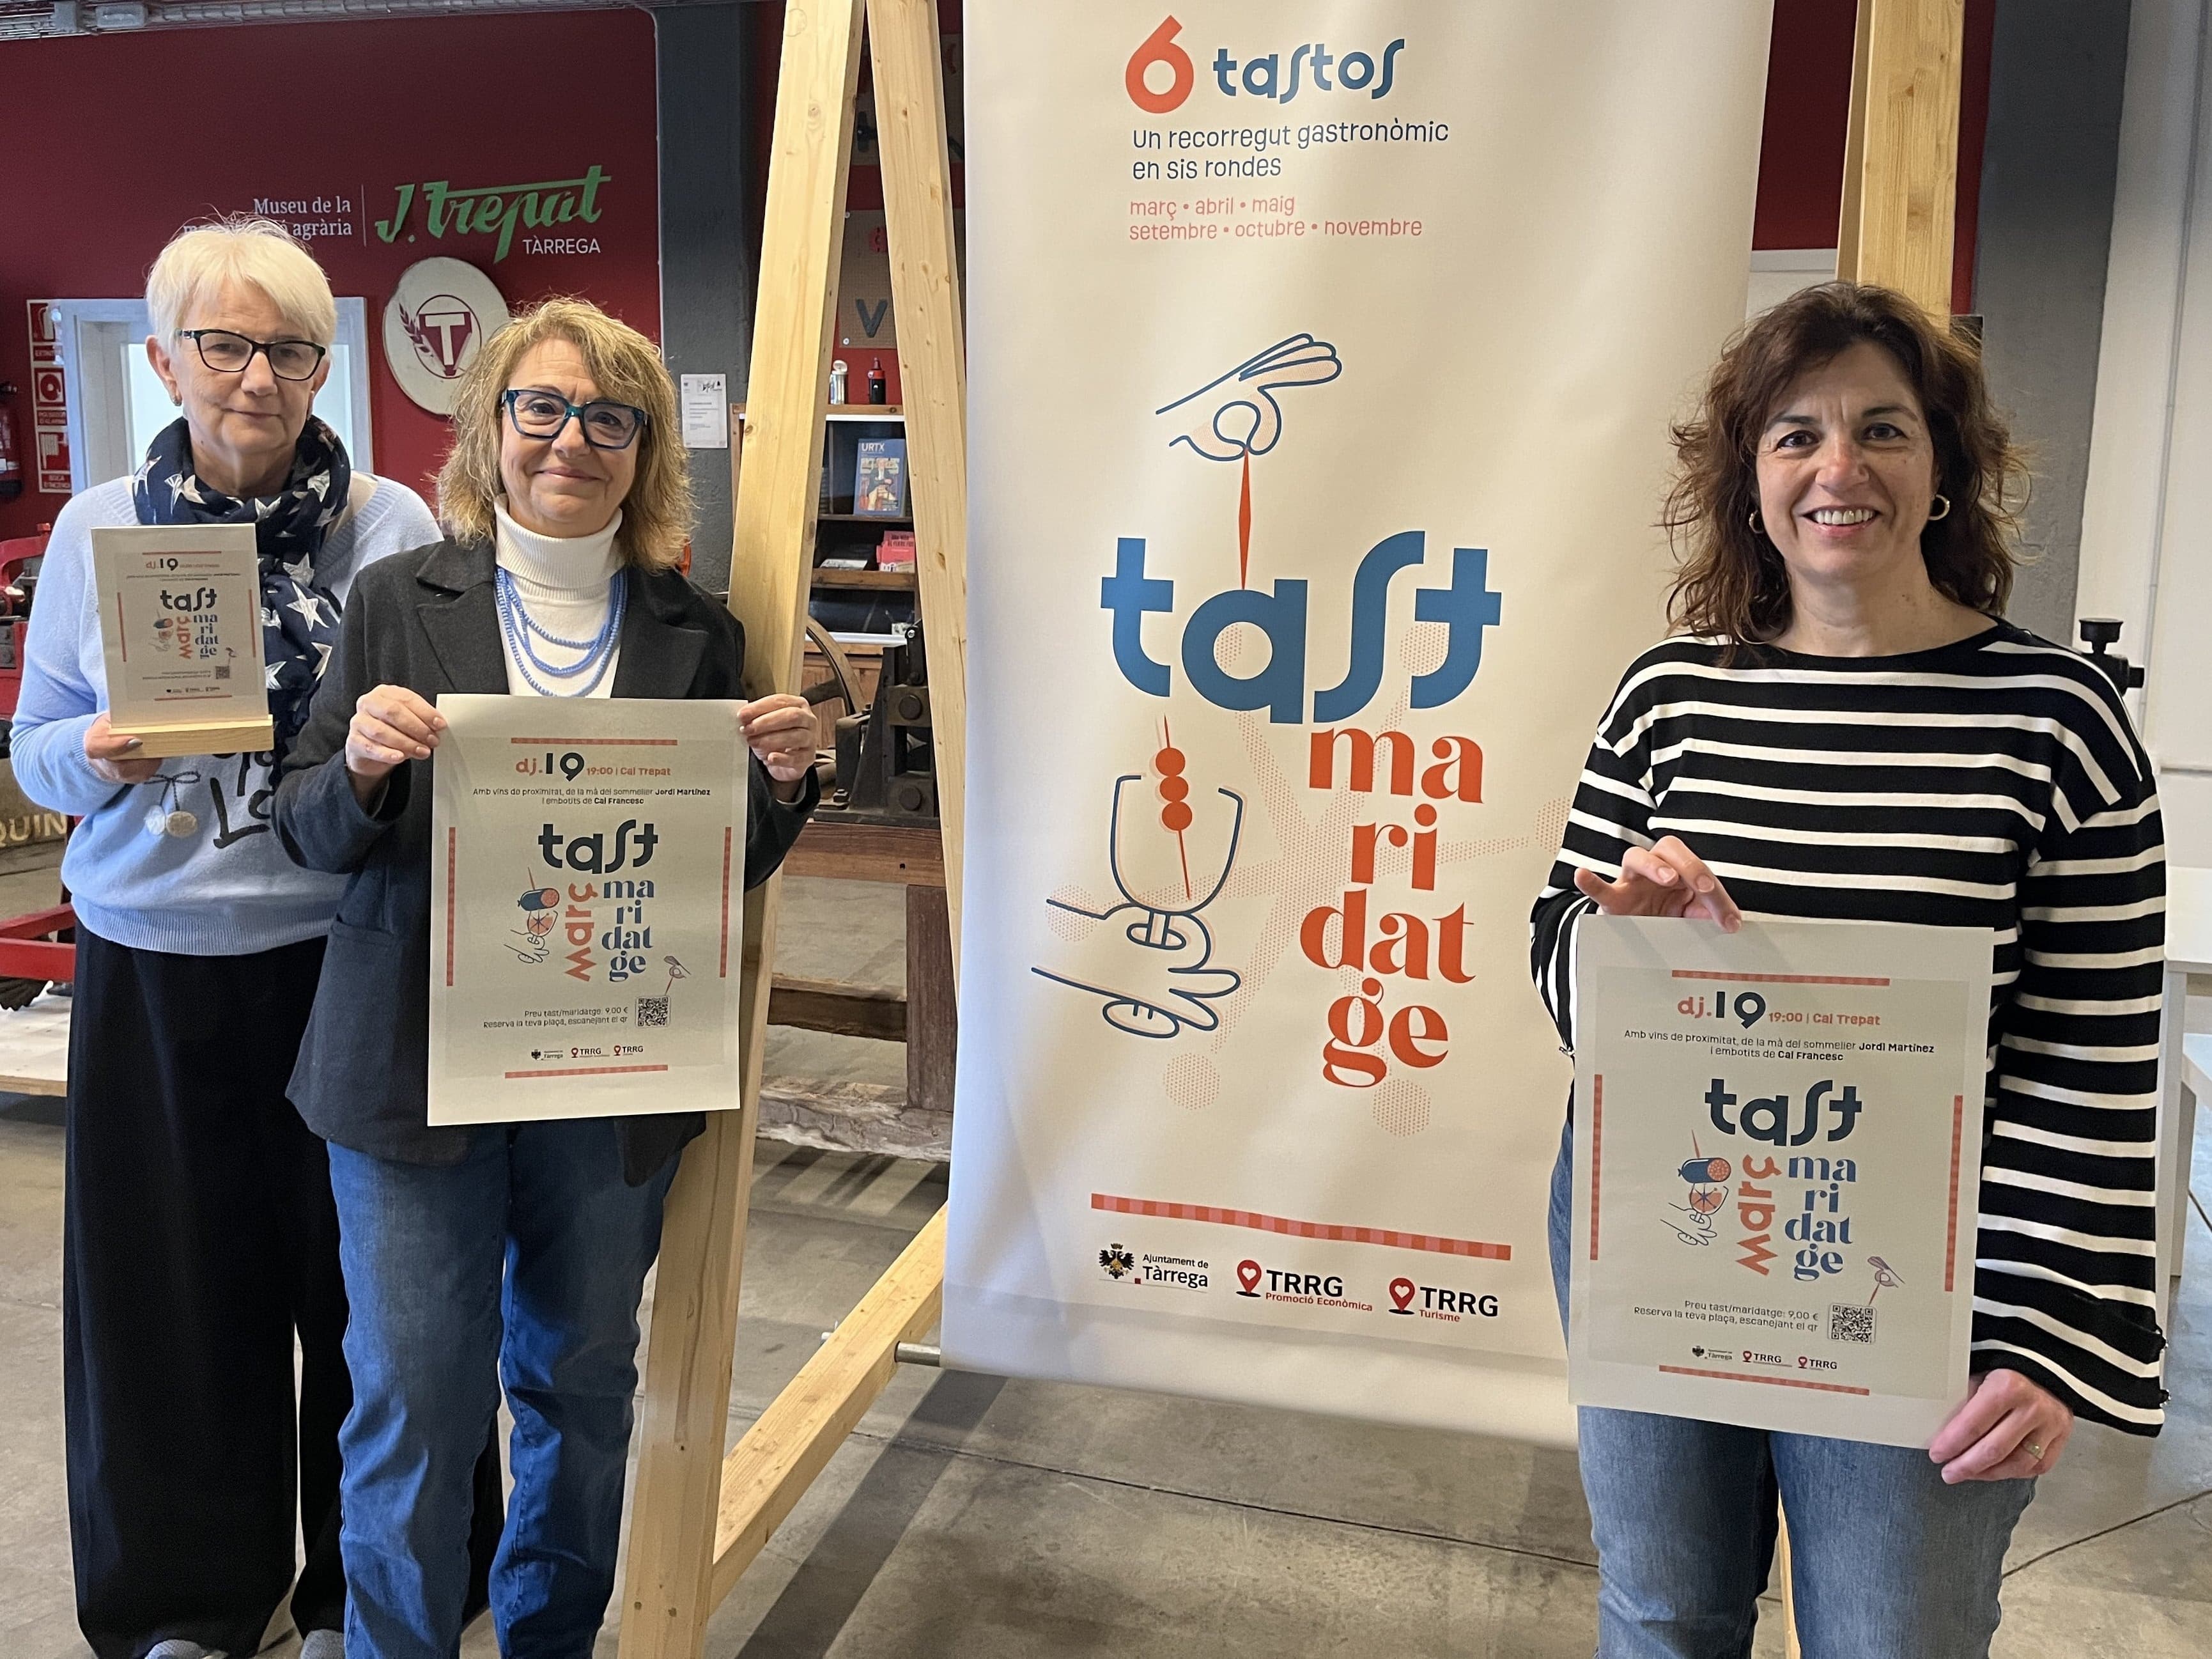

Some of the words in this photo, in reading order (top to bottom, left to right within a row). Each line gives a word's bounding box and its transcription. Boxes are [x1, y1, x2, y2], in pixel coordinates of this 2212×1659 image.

[1125, 15, 1194, 113] 6
[1213, 38, 1405, 104] tastos
[1133, 129, 1161, 149] Un
[1169, 125, 1290, 152] recorregut
[1297, 118, 1449, 149] gastronòmic
[1133, 160, 1159, 180] en
[1167, 158, 1198, 179] sis
[1205, 156, 1281, 178] rondes
[254, 198, 307, 214] Museu
[312, 196, 332, 214] de
[337, 196, 351, 213] la
[1130, 199, 1177, 221] març
[1195, 197, 1234, 215] abril
[1252, 196, 1295, 216] maig
[293, 219, 352, 240] agrària
[1129, 222, 1217, 240] setembre
[1235, 220, 1305, 238] octubre
[1324, 218, 1423, 237] novembre
[523, 235, 600, 254] TÀRREGA
[862, 442, 885, 452] URTX
[160, 587, 217, 612] tast
[194, 614, 218, 623] ma
[201, 623, 213, 634] ri
[1101, 531, 1502, 724] tast
[195, 634, 219, 645] dat
[200, 646, 217, 659] ge
[587, 767, 613, 775] 19:00
[621, 767, 635, 775] Cal
[638, 768, 670, 777] Trepat
[1309, 728, 1483, 804] ma
[538, 820, 658, 874] tast
[1351, 804, 1437, 891] ri
[604, 880, 654, 899] ma
[616, 900, 642, 924] ri
[601, 926, 653, 950] dat
[1300, 888, 1476, 984] dat
[609, 951, 646, 982] ge
[1768, 1012, 1802, 1022] 19:00
[1813, 1013, 1833, 1024] Cal
[1837, 1014, 1881, 1026] Trepat
[1323, 977, 1448, 1087] ge
[1625, 1030, 1646, 1039] Amb
[1648, 1031, 1668, 1040] vins
[1671, 1032, 1683, 1041] de
[1685, 1034, 1739, 1046] proximitat,
[1742, 1037, 1753, 1046] de
[1757, 1038, 1765, 1047] la
[1768, 1038, 1783, 1047] mà
[1786, 1040, 1800, 1048] del
[1804, 1040, 1856, 1050] sommelier
[1859, 1042, 1885, 1052] Jordi
[1715, 1047, 1760, 1057] embotits
[1763, 1049, 1775, 1058] de
[1778, 1051, 1793, 1059] Cal
[1797, 1052, 1844, 1061] Francesc
[1705, 1079, 1862, 1146] tast
[1789, 1157, 1857, 1182] ma
[1804, 1183, 1839, 1213] ri
[1784, 1213, 1853, 1244] dat
[1143, 1254, 1195, 1267] Ajuntament
[1197, 1260, 1209, 1268] de
[1793, 1243, 1844, 1281] ge
[1143, 1265, 1208, 1288] Tàrrega
[1266, 1270, 1343, 1297] TRRG
[1265, 1292, 1313, 1305] Promoció
[1317, 1297, 1373, 1312] Econòmica
[1419, 1286, 1498, 1317] TRRG
[1685, 1300, 1706, 1310] Preu
[1788, 1311, 1809, 1320] 9,00
[1813, 1312, 1819, 1321] €
[1419, 1309, 1460, 1323] Turisme
[1634, 1307, 1672, 1317] Reserva
[1674, 1310, 1683, 1318] la
[1685, 1311, 1706, 1320] teva
[1708, 1313, 1738, 1325] plaça,
[1739, 1316, 1793, 1329] escanejant
[1796, 1321, 1805, 1330] el
[1807, 1324, 1818, 1332] qr
[1754, 1353, 1782, 1363] TRRG
[1809, 1359, 1837, 1369] TRRG
